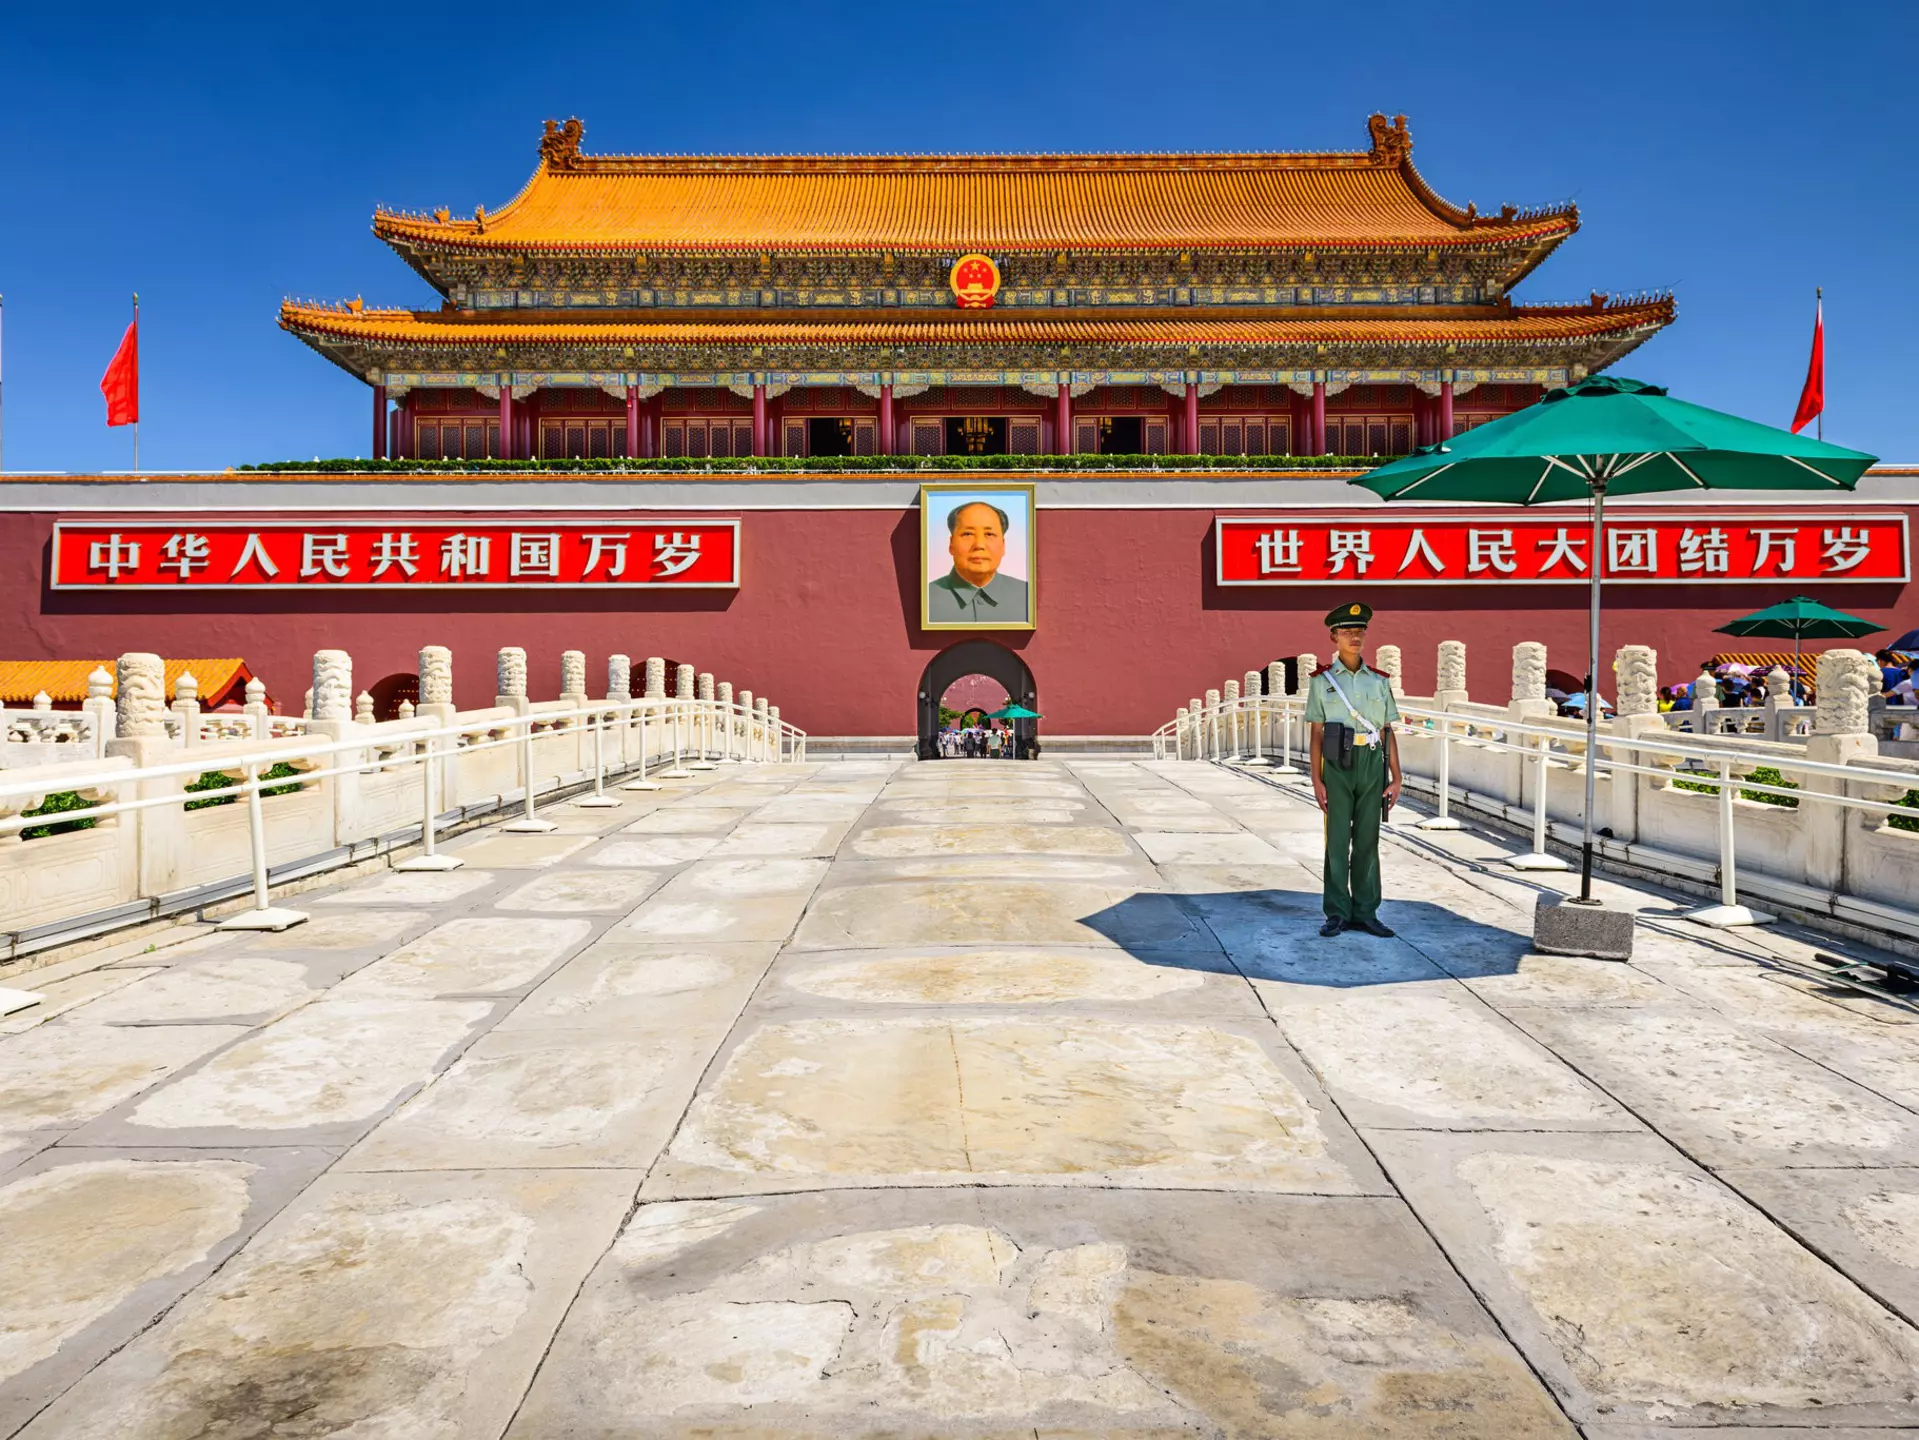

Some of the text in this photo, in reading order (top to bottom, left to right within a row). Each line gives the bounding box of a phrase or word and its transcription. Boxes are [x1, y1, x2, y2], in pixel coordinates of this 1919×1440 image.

[89, 532, 702, 578] 中华人民共和国万岁
[1256, 527, 1871, 573] 世界人民大团结万岁
